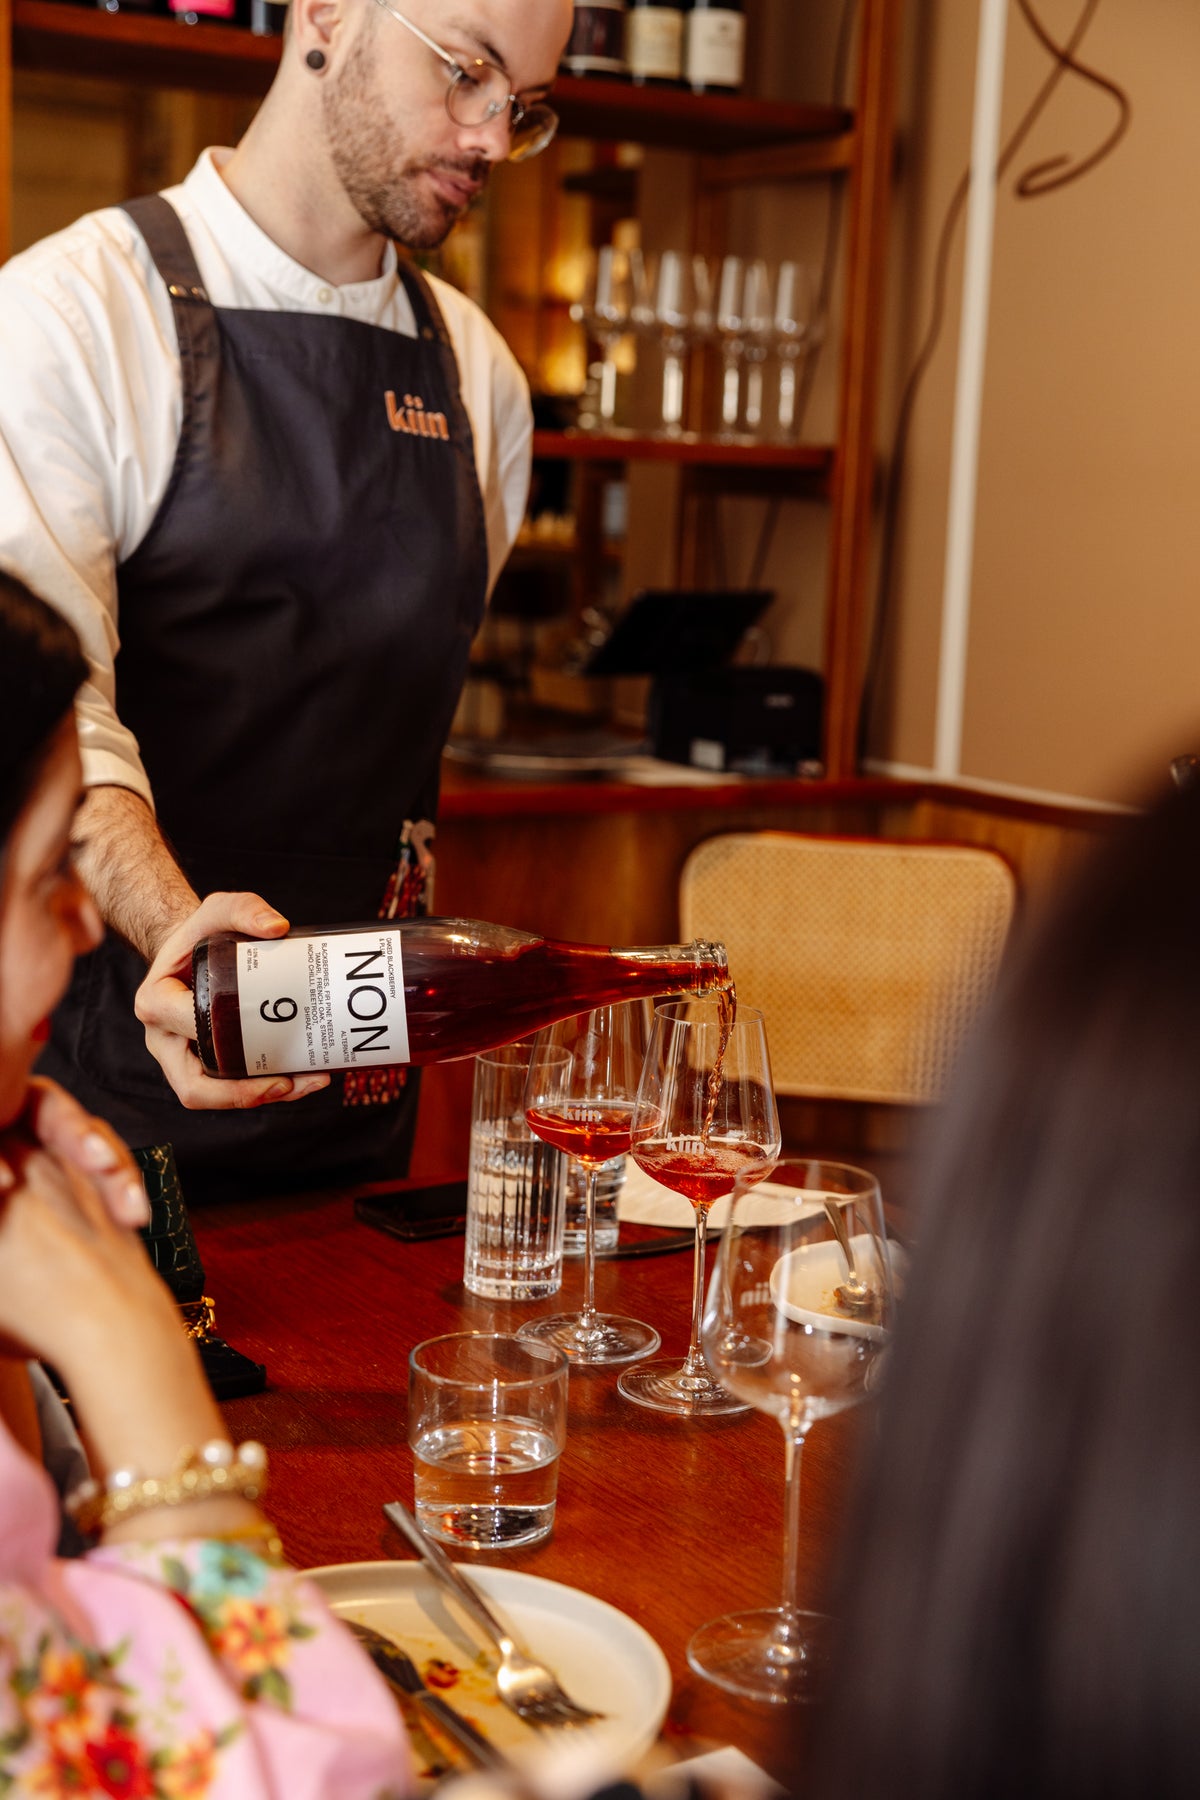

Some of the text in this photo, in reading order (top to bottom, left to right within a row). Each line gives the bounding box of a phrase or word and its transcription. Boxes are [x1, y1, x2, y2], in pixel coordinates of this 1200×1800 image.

[384, 390, 449, 440] kiin
[322, 943, 330, 988] BLACKBERRIES,
[327, 1020, 335, 1048] NEEDLES,
[388, 956, 396, 998] BLACKBERRY
[345, 951, 390, 1052] NON
[320, 1025, 328, 1050] STANLEY
[341, 1031, 349, 1063] ALTERNATIVE
[563, 1101, 601, 1122] kiin
[666, 1132, 705, 1155] kiin
